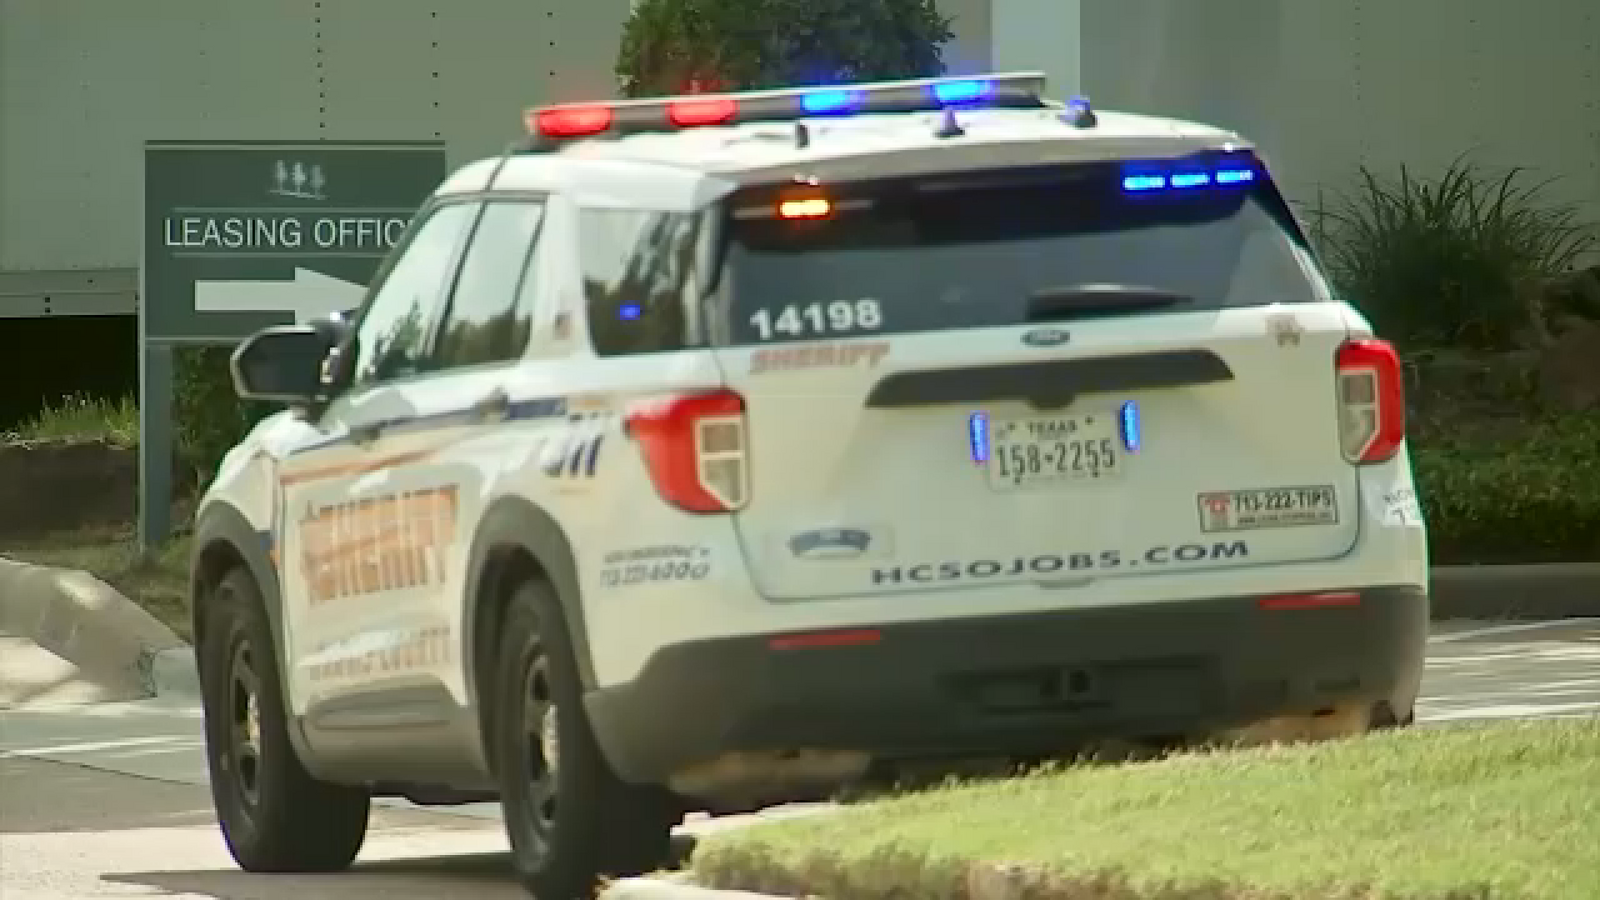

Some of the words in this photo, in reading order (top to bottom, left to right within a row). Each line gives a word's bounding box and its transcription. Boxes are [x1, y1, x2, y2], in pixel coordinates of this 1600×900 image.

[164, 217, 301, 248] LEASING
[314, 217, 413, 248] OFFIC
[750, 298, 882, 341] 14198
[750, 341, 891, 374] SHERIFF
[1027, 419, 1078, 439] TEXAS
[1236, 488, 1333, 513] 713-222-TIPS
[872, 539, 1250, 585] HCSOJOBS.COM
